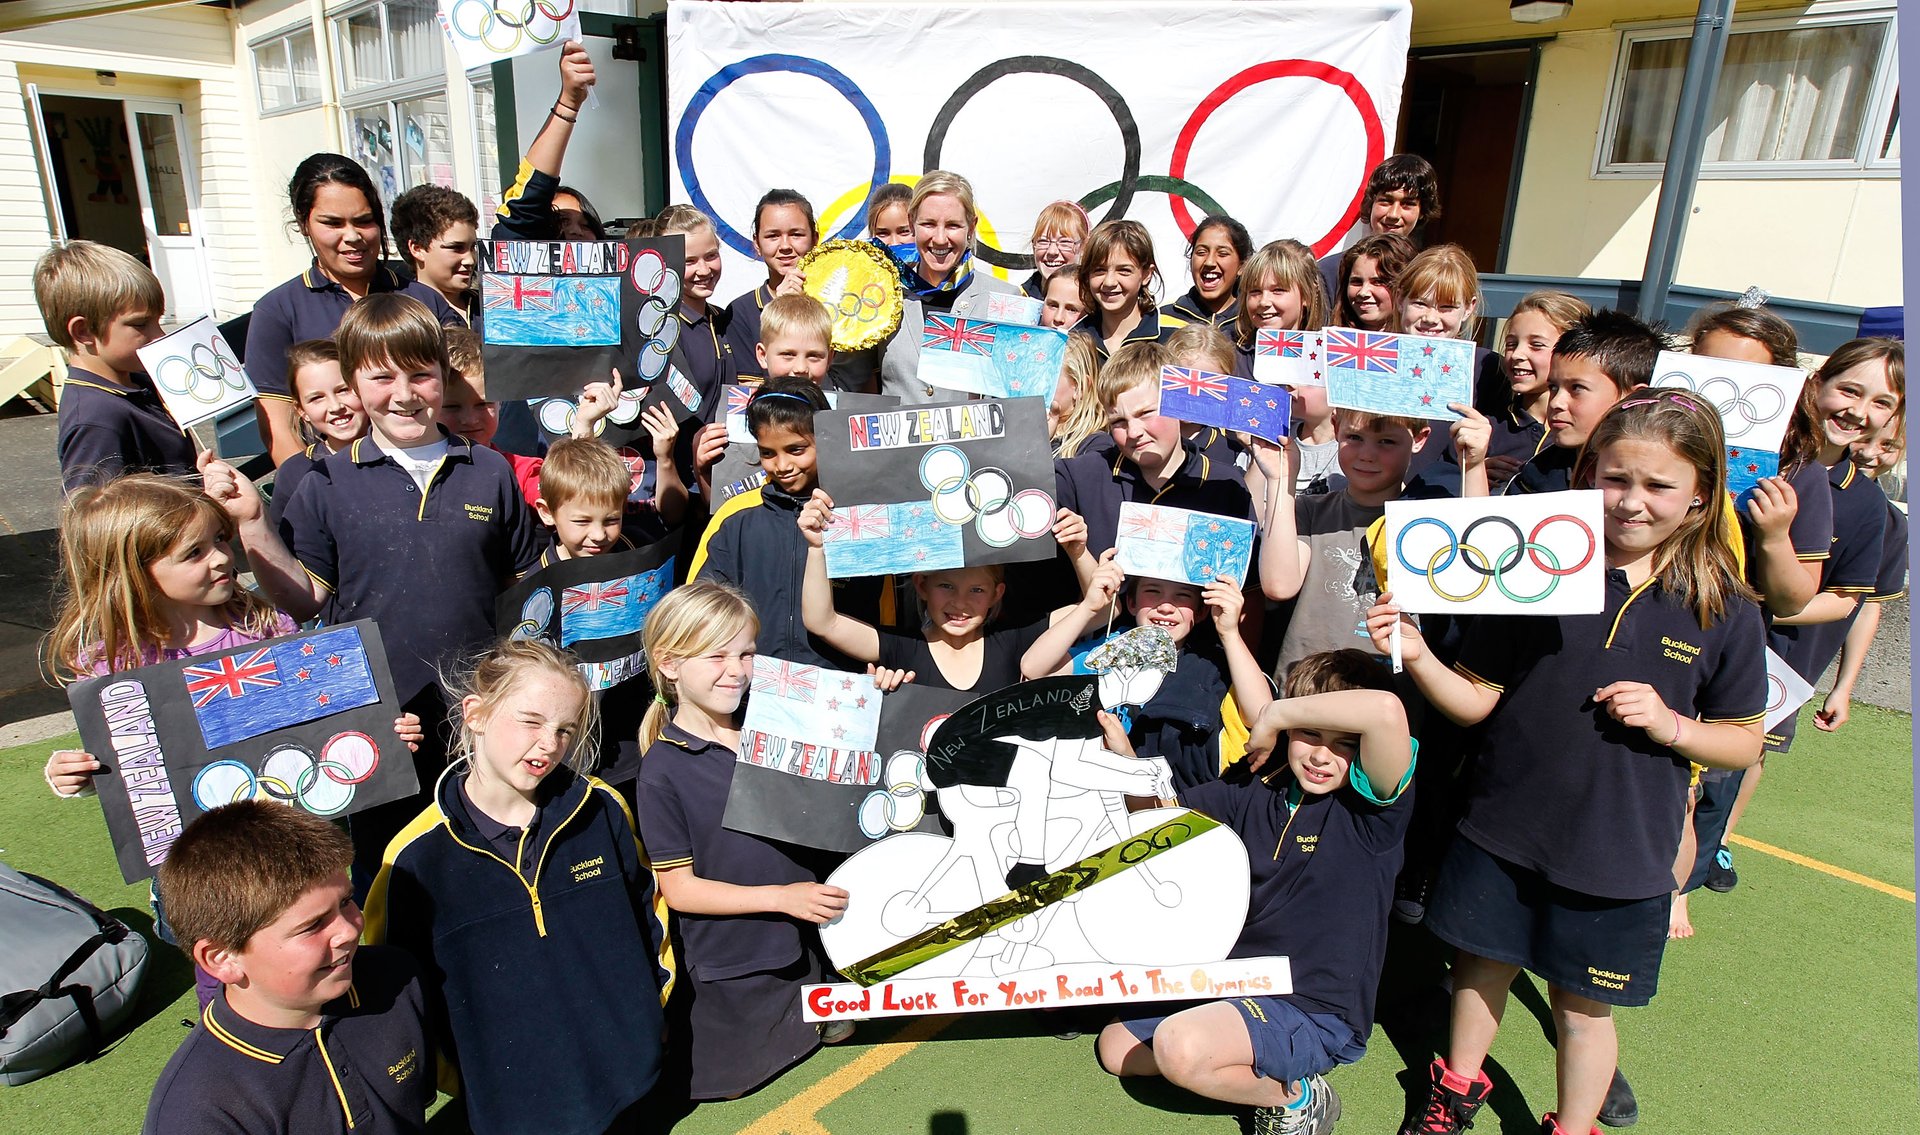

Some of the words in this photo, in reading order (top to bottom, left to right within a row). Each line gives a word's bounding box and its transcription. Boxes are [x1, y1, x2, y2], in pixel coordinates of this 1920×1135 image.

[149, 166, 178, 175] HALL
[478, 241, 531, 274] NEW
[537, 242, 630, 275] ZEALAND
[666, 363, 703, 412] LAND
[850, 413, 901, 449] NEW
[906, 403, 1005, 444] ZEALAND
[464, 503, 493, 514] Buckland
[468, 512, 490, 522] School
[1660, 636, 1702, 656] Buckland
[1663, 648, 1693, 665] School
[600, 651, 647, 689] ZEAL
[100, 679, 175, 804] ZEALAND
[737, 728, 787, 769] NEW
[788, 740, 883, 785] ZEALAND
[1296, 835, 1320, 843] Buckl
[1301, 844, 1315, 852] Sch
[574, 866, 602, 883] School
[1588, 966, 1630, 981] Buckland
[1592, 976, 1624, 990] School
[808, 987, 871, 1018] Good
[882, 984, 939, 1011] Luck
[952, 980, 989, 1007] For
[997, 981, 1048, 1007] Your
[1056, 974, 1104, 1000] Road
[1109, 970, 1139, 998] To
[1145, 969, 1185, 995] The
[1191, 968, 1273, 996] Olympics
